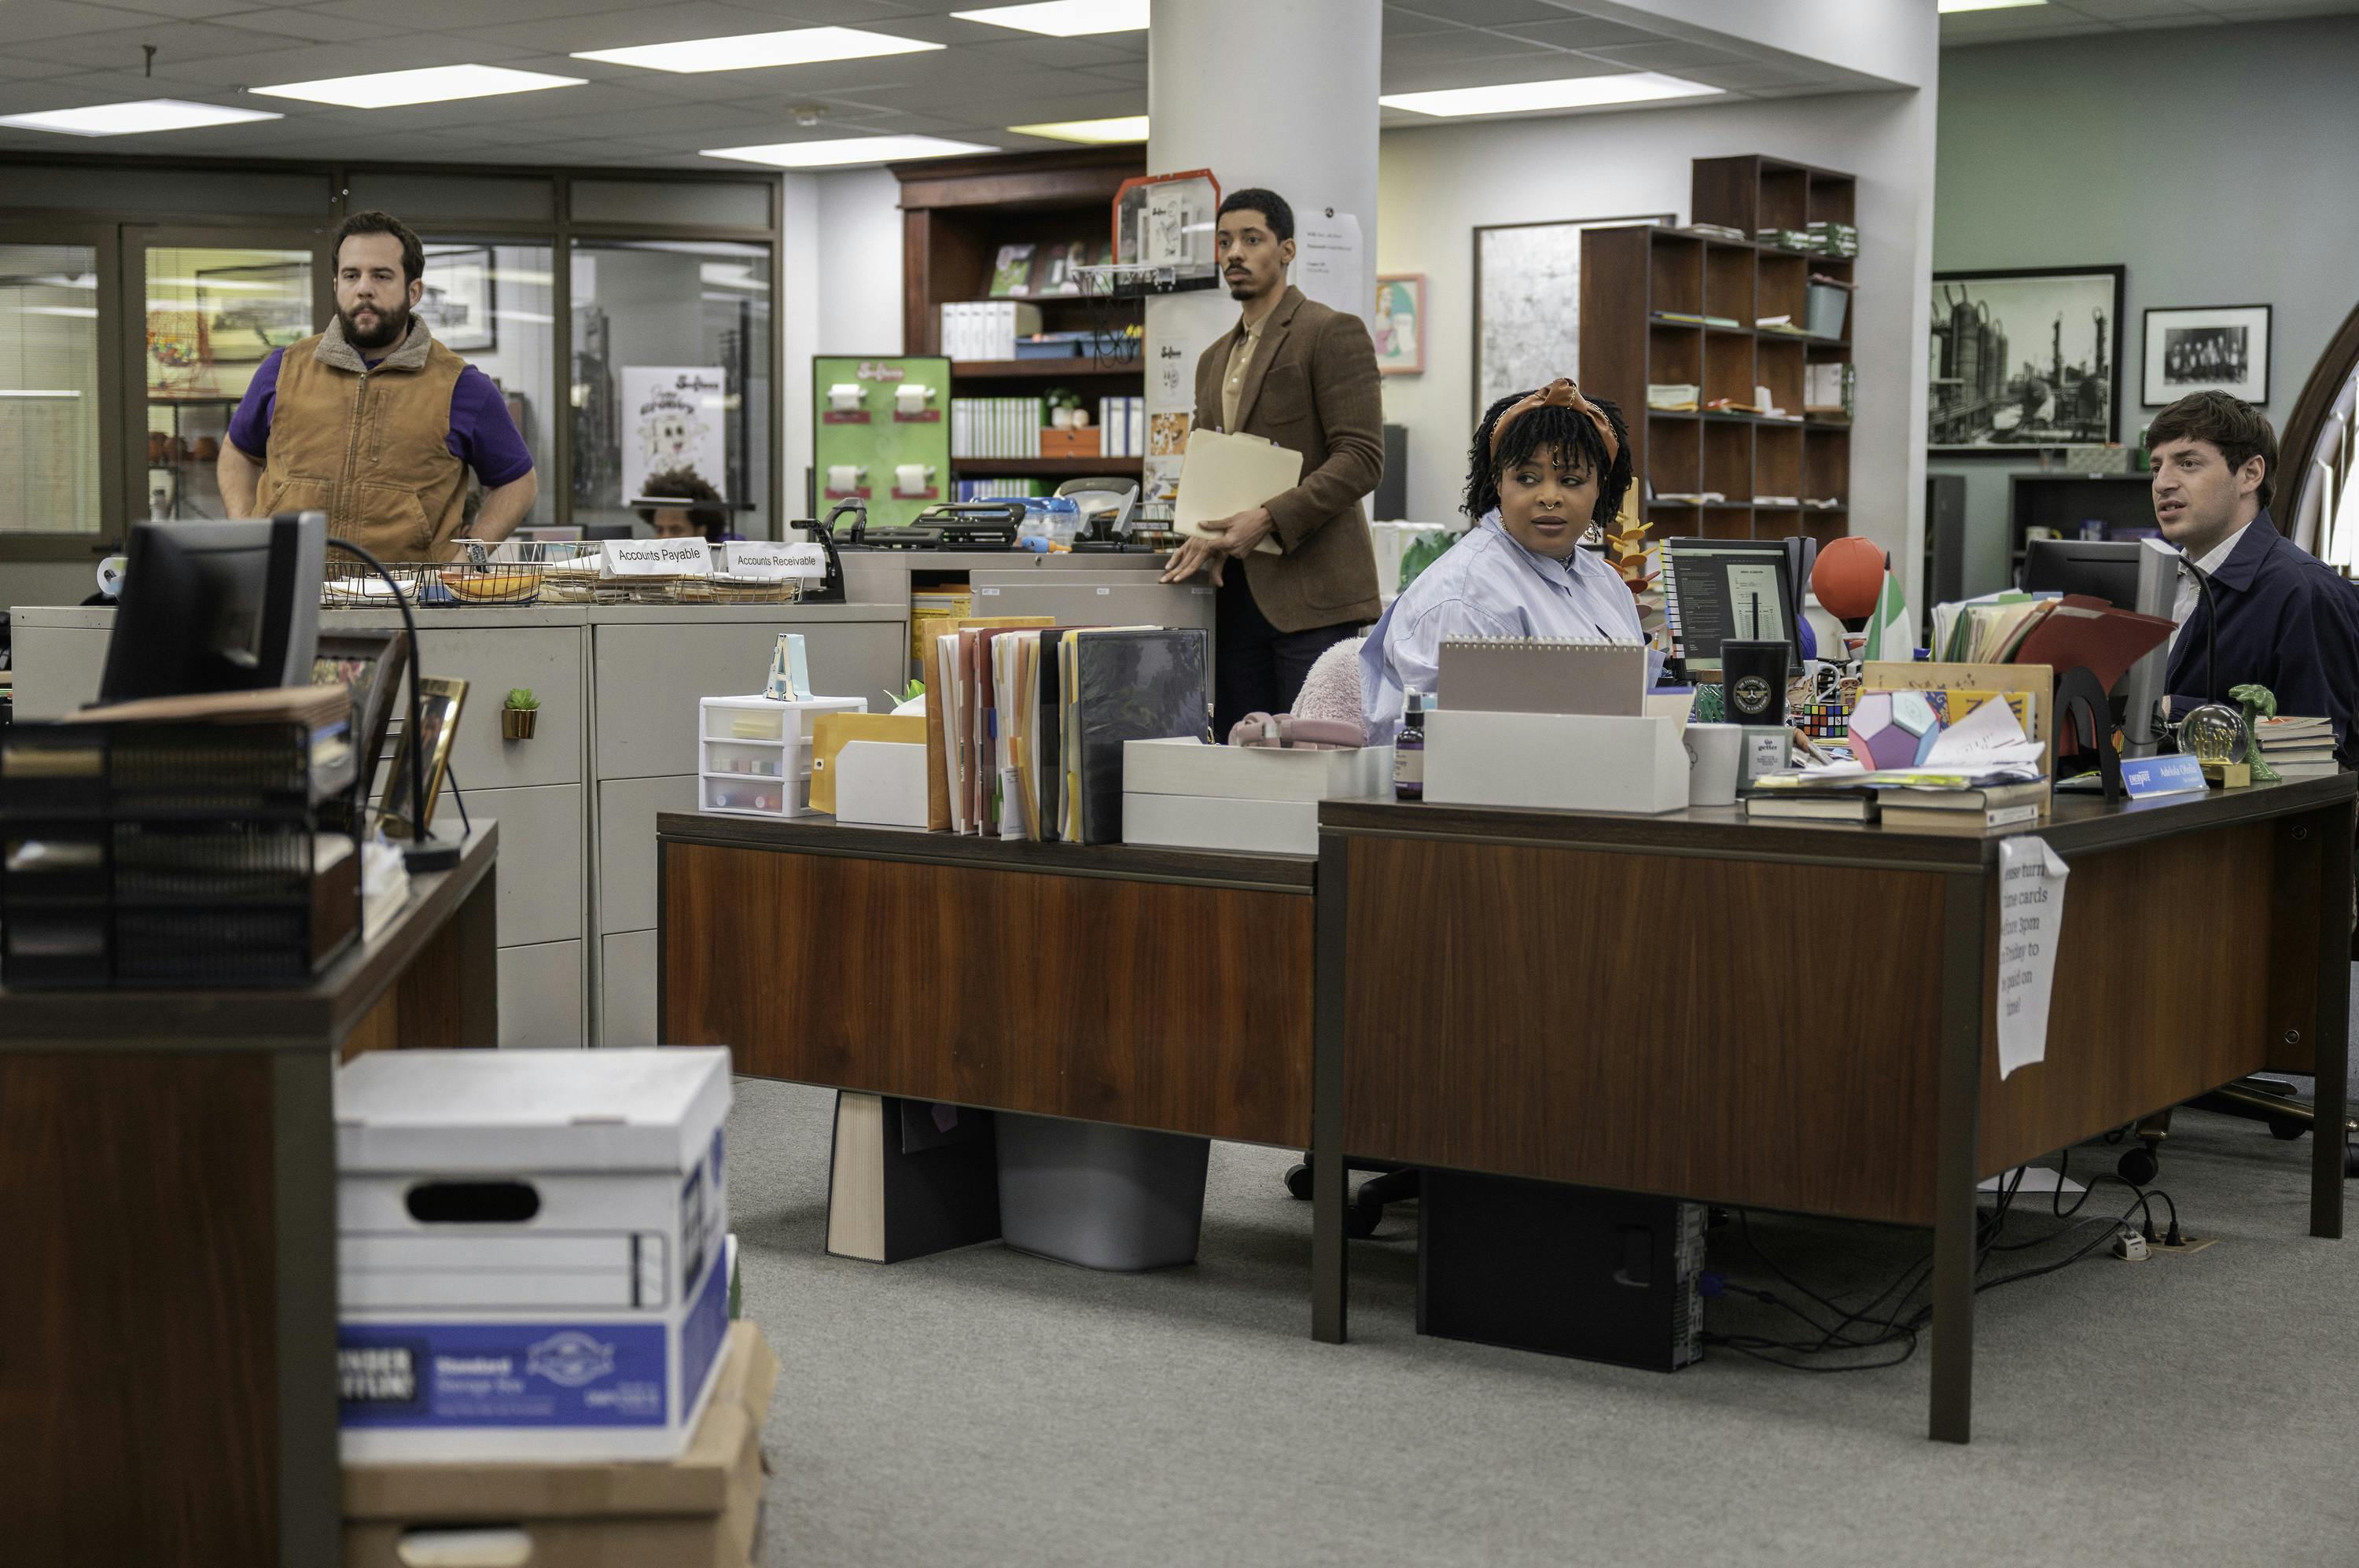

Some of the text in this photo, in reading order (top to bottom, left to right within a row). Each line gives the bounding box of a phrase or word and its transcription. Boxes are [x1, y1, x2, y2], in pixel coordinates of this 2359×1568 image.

[619, 548, 701, 565] Accounts Payable
[738, 555, 816, 566] Accounts Receivable
[2022, 863, 2045, 877] turn
[2019, 887, 2048, 904] cards
[2028, 943, 2040, 956] to
[2021, 971, 2033, 985] on
